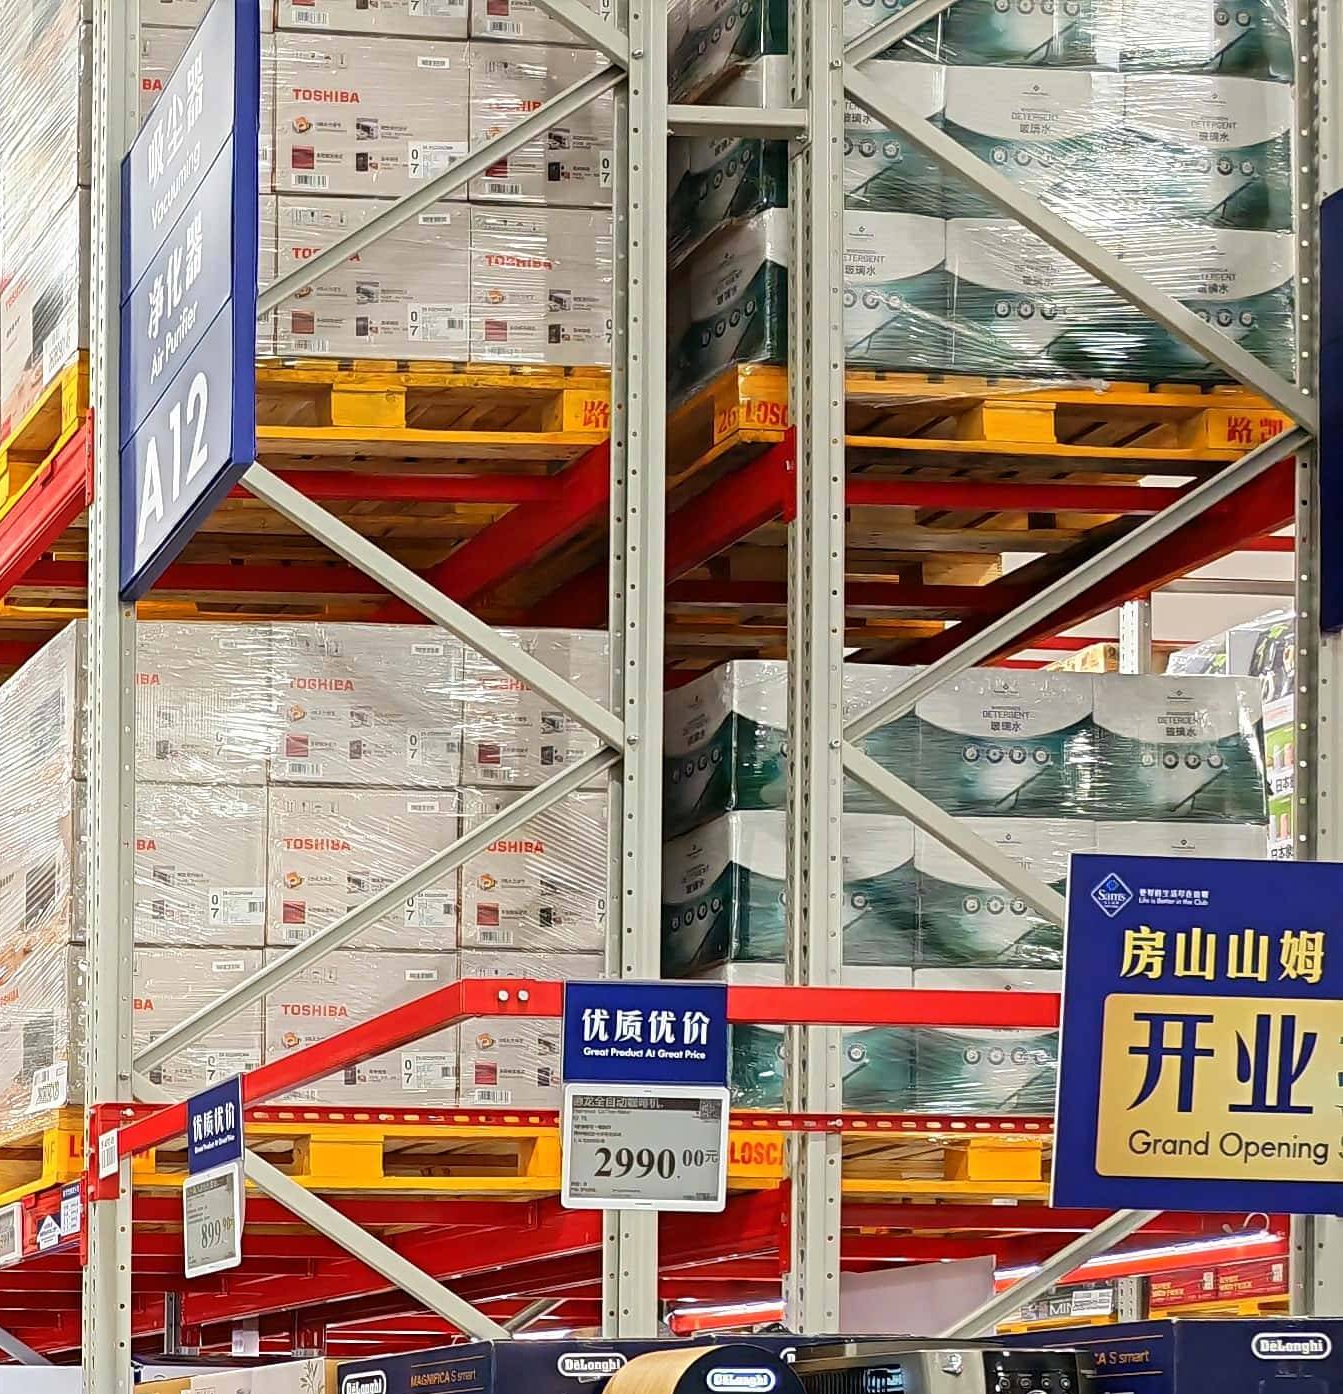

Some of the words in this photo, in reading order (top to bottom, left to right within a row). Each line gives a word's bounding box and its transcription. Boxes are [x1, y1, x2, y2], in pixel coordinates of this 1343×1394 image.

[292, 87, 361, 104] TOSHIBA
[146, 50, 204, 190] 吸尘器
[149, 138, 202, 232] Vacuuming
[146, 208, 203, 341] 净化器
[149, 346, 164, 385] Air
[164, 301, 198, 369] Purifier
[136, 371, 209, 548] A12
[990, 720, 1023, 733] 玻璃水
[1165, 726, 1197, 738] 玻璃水
[283, 837, 351, 852] TOSHIBA
[1119, 925, 1327, 984] 房山山姆
[281, 1003, 349, 1018] TOSHIBA
[582, 1008, 711, 1045] 优质优价
[583, 1047, 609, 1057] Great
[610, 1048, 643, 1058] Product
[644, 1049, 656, 1058] At
[657, 1050, 684, 1060] Great
[685, 1050, 707, 1060] Price
[1126, 1012, 1343, 1115] 开业
[192, 1101, 236, 1142] 优质优价
[1128, 1129, 1210, 1156] Grand
[1219, 1132, 1329, 1165] Opening
[1109, 1351, 1117, 1365] S
[1118, 1350, 1150, 1365] smart
[409, 1373, 450, 1388] MAGNIFICA
[457, 1369, 477, 1382] smart
